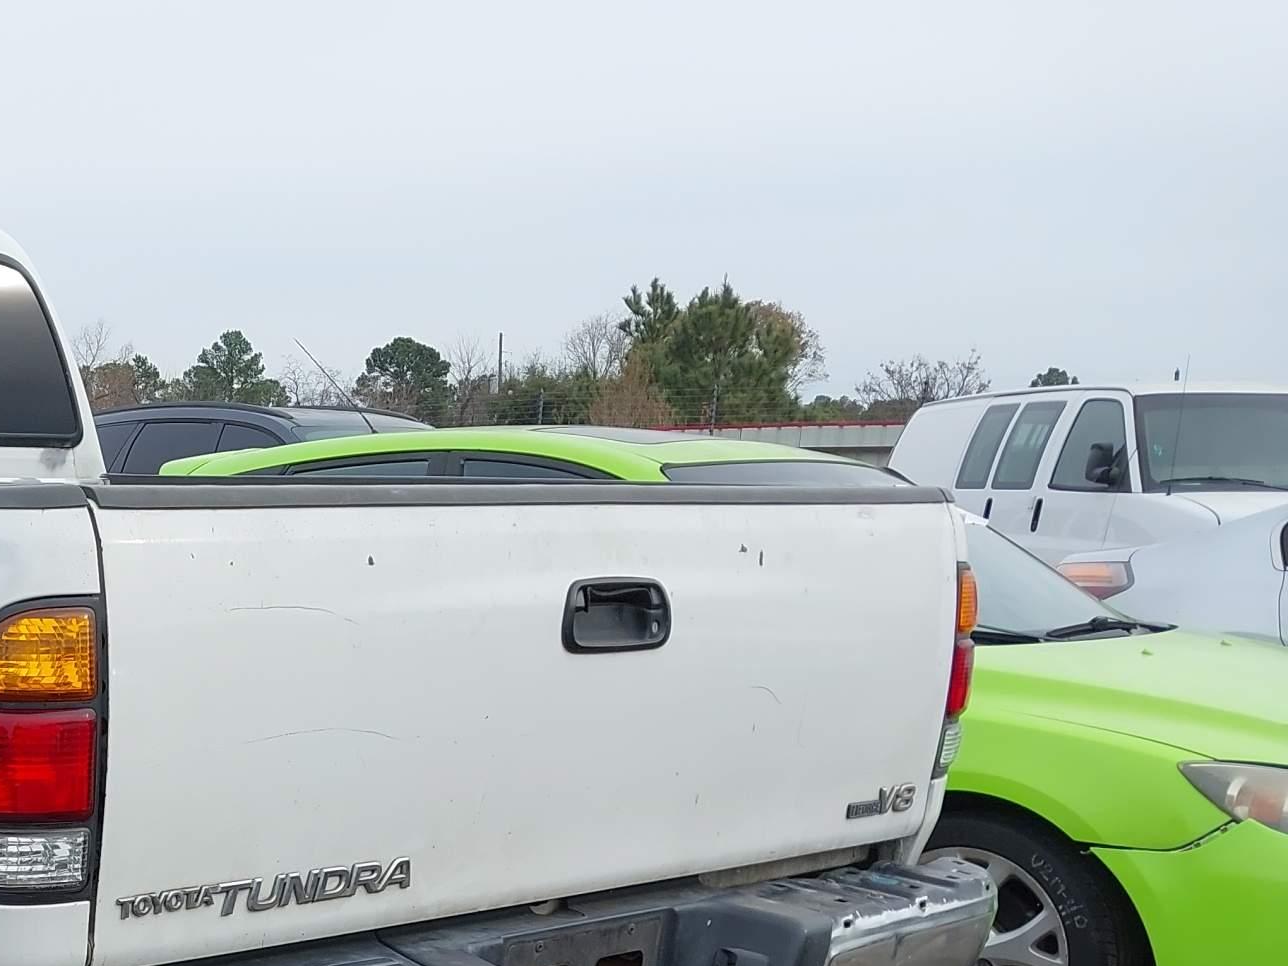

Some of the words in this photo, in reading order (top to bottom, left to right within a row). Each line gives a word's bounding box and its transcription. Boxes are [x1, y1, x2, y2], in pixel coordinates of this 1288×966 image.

[879, 782, 916, 814] V8
[116, 885, 214, 920] TOYOTA
[214, 856, 411, 917] TUNDRA
